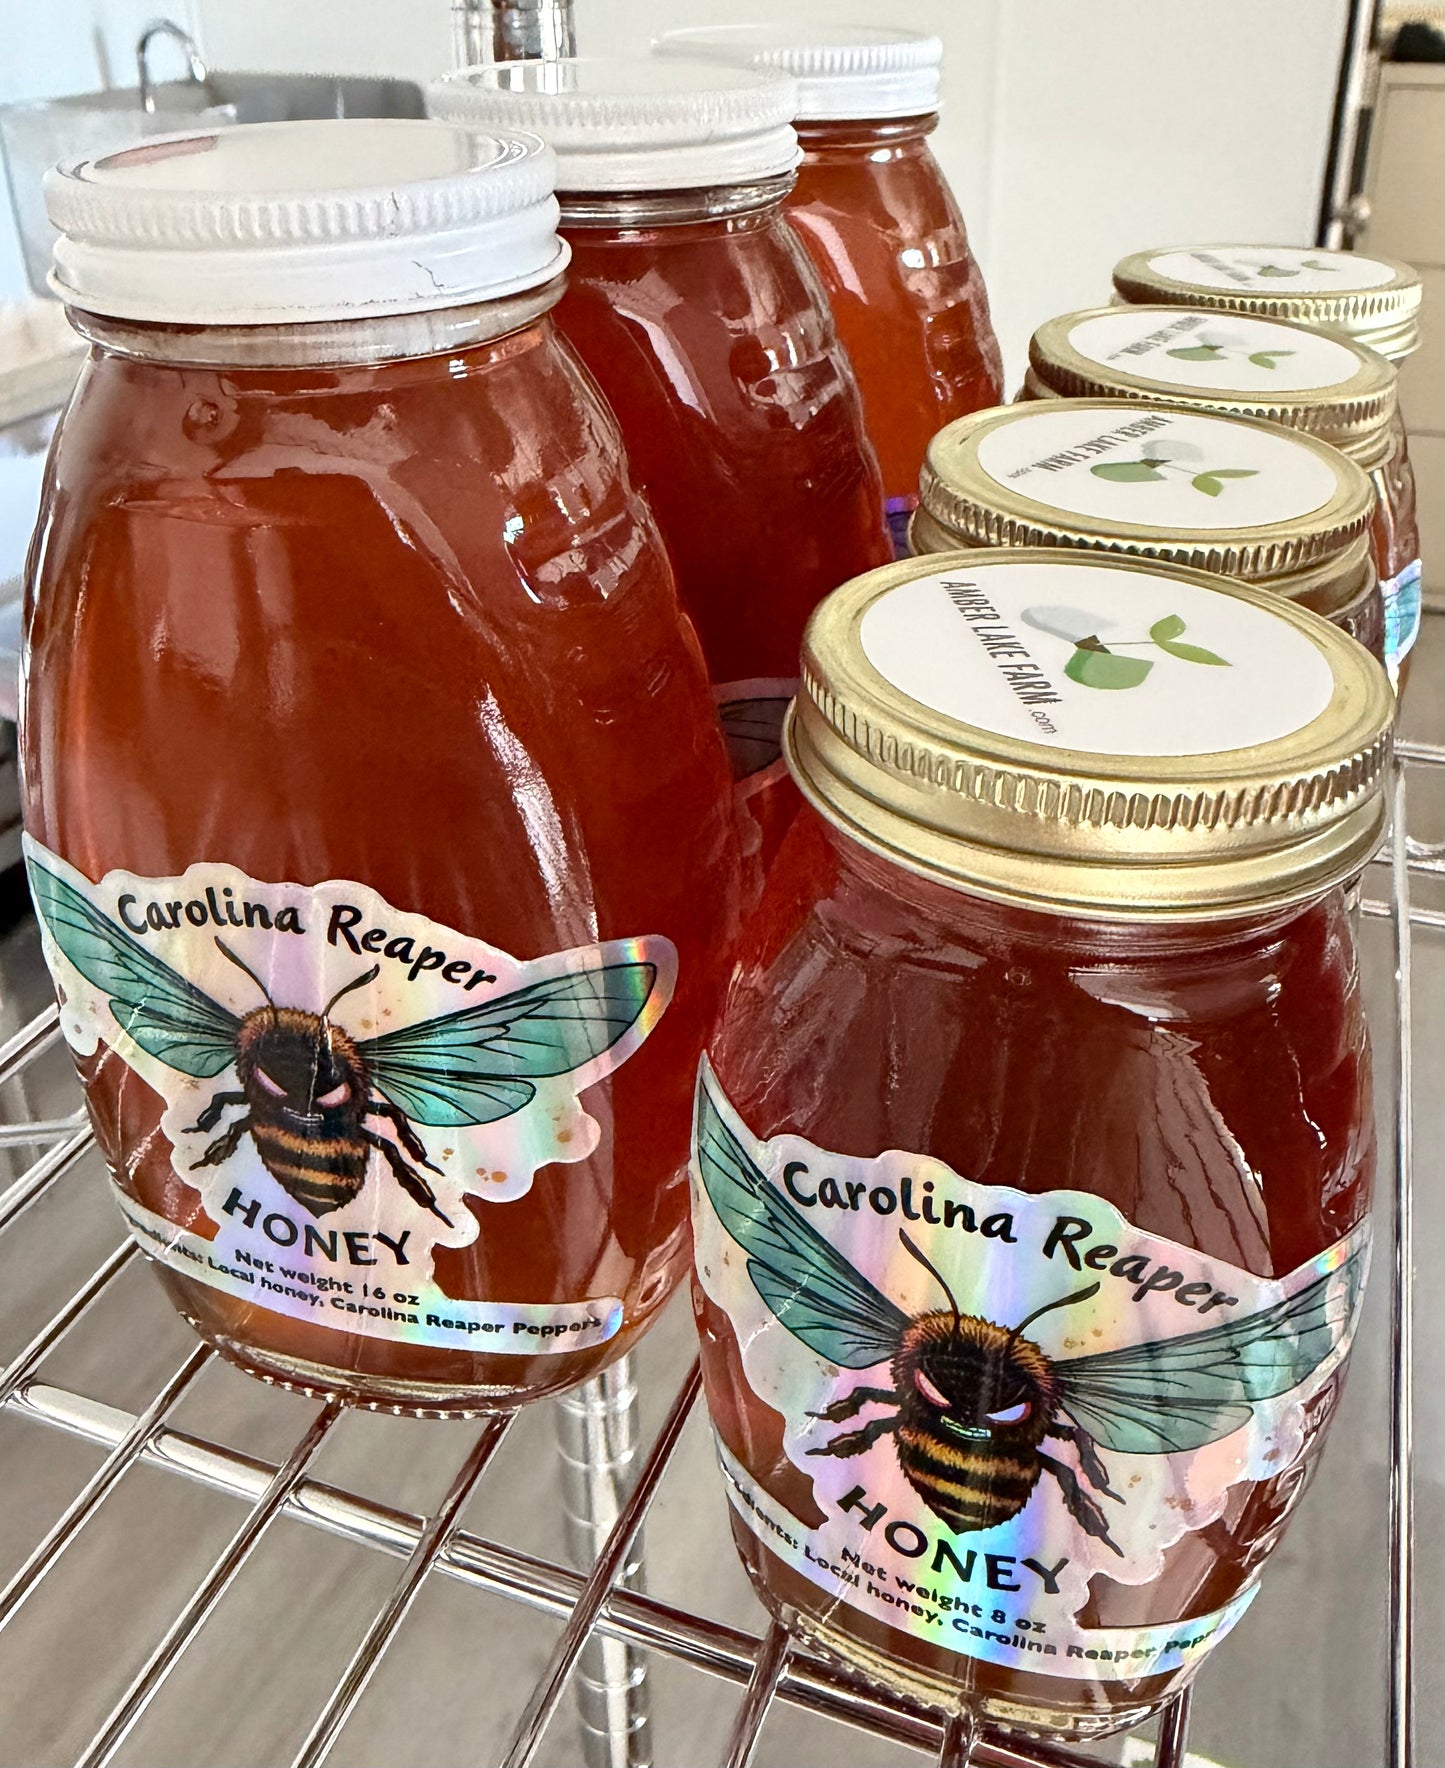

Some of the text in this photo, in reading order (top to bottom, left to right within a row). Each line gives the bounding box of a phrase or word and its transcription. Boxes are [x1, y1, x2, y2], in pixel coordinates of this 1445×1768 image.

[940, 581, 1063, 734] AMBER LAKE FARM .com
[117, 886, 497, 991] Carolina Reaper
[221, 1187, 411, 1266] HONEY
[235, 1248, 421, 1306] Net weight 16 oz
[783, 1161, 1239, 1314] Carolina Reaper
[207, 1255, 255, 1284] Local
[260, 1276, 325, 1307] honey,
[330, 1296, 420, 1325] Carolina
[425, 1314, 505, 1335] Reaper
[836, 1484, 1070, 1595] HONEY
[840, 1547, 1048, 1635] Net weight 8 oz
[804, 1544, 860, 1588] Local
[867, 1581, 944, 1627] honey,
[952, 1618, 1058, 1657] Carolina
[1066, 1644, 1157, 1664] Reaper
